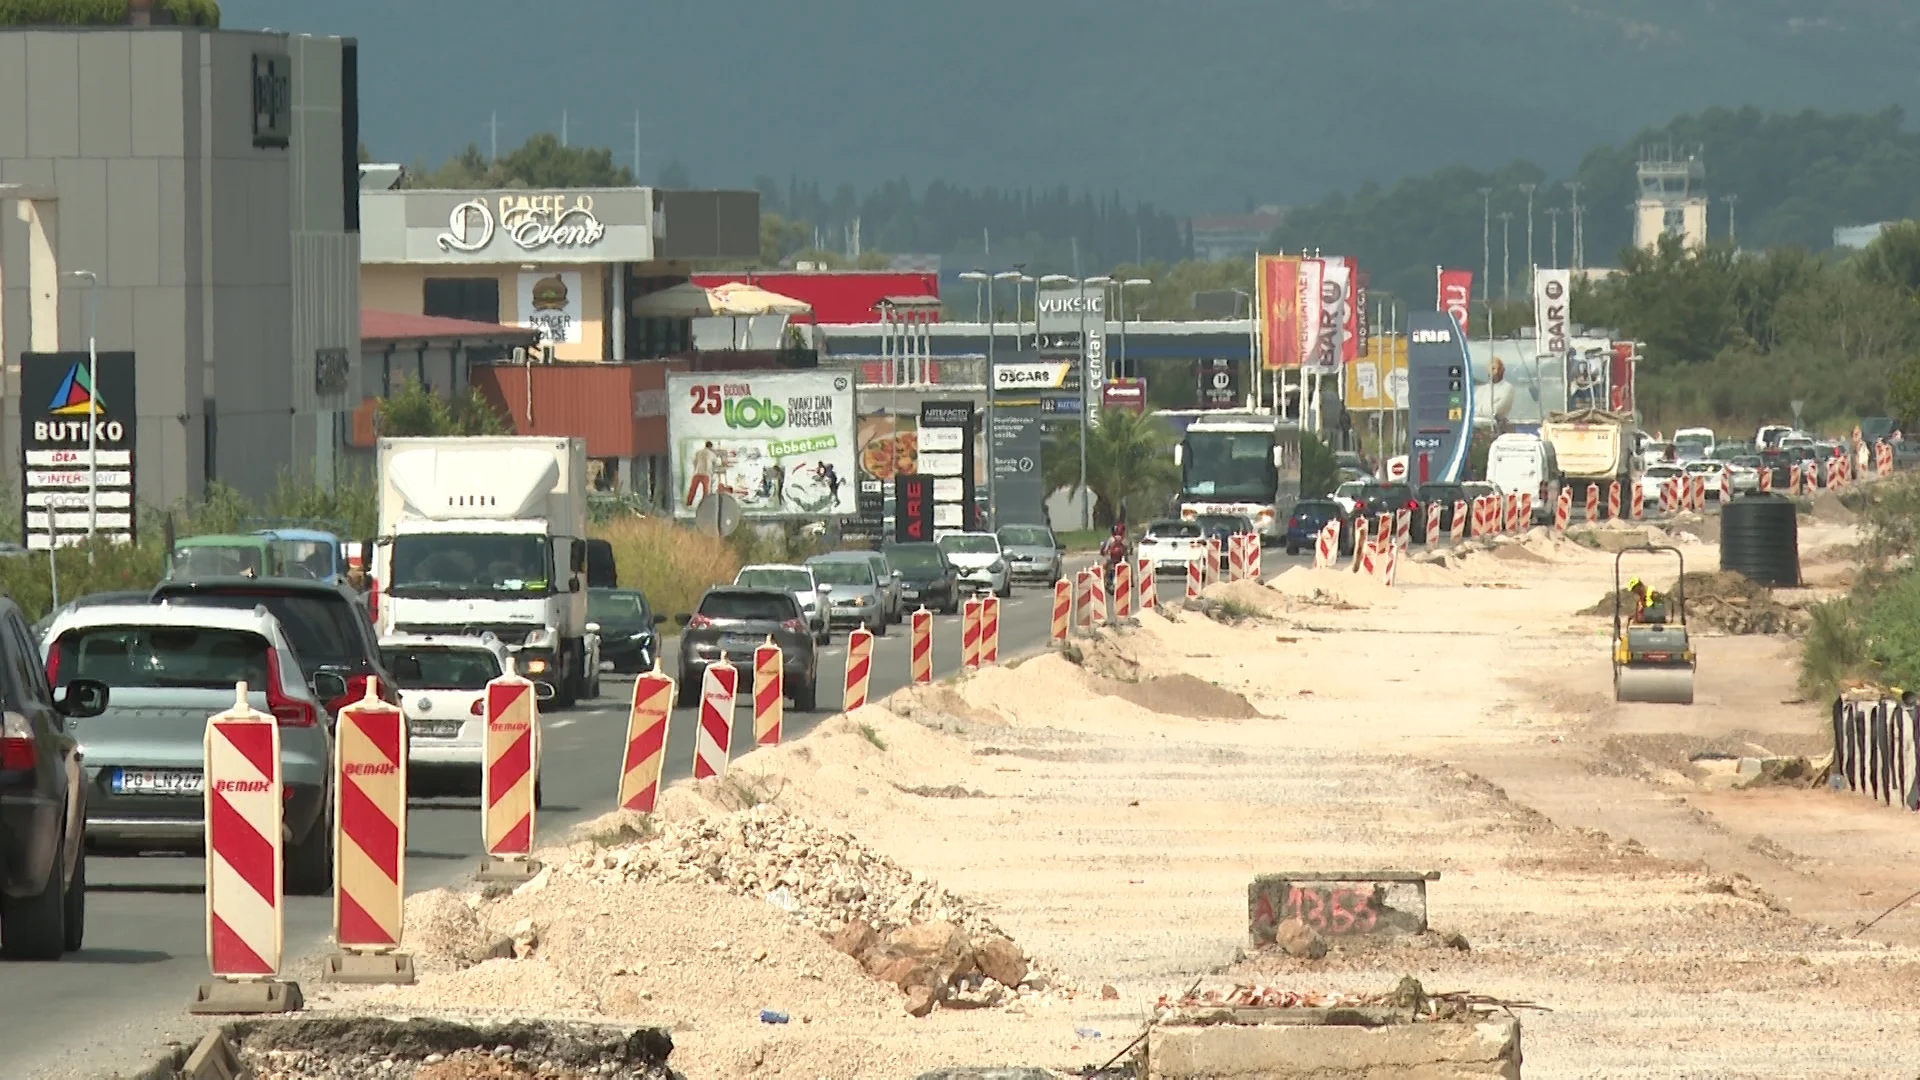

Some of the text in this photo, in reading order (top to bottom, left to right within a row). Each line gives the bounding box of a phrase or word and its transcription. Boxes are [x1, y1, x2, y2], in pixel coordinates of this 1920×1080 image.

[540, 328, 568, 342] OUSE
[1320, 308, 1339, 366] BAR
[1548, 304, 1566, 354] BAR
[1087, 328, 1102, 390] centar
[689, 384, 722, 416] 25
[723, 384, 752, 397] GODINA
[788, 395, 832, 410] SVAKI DAN
[788, 409, 832, 428] POSEBAN
[34, 420, 124, 441] BUTIKO
[771, 437, 835, 456] lobbet.me
[125, 773, 143, 788] PG
